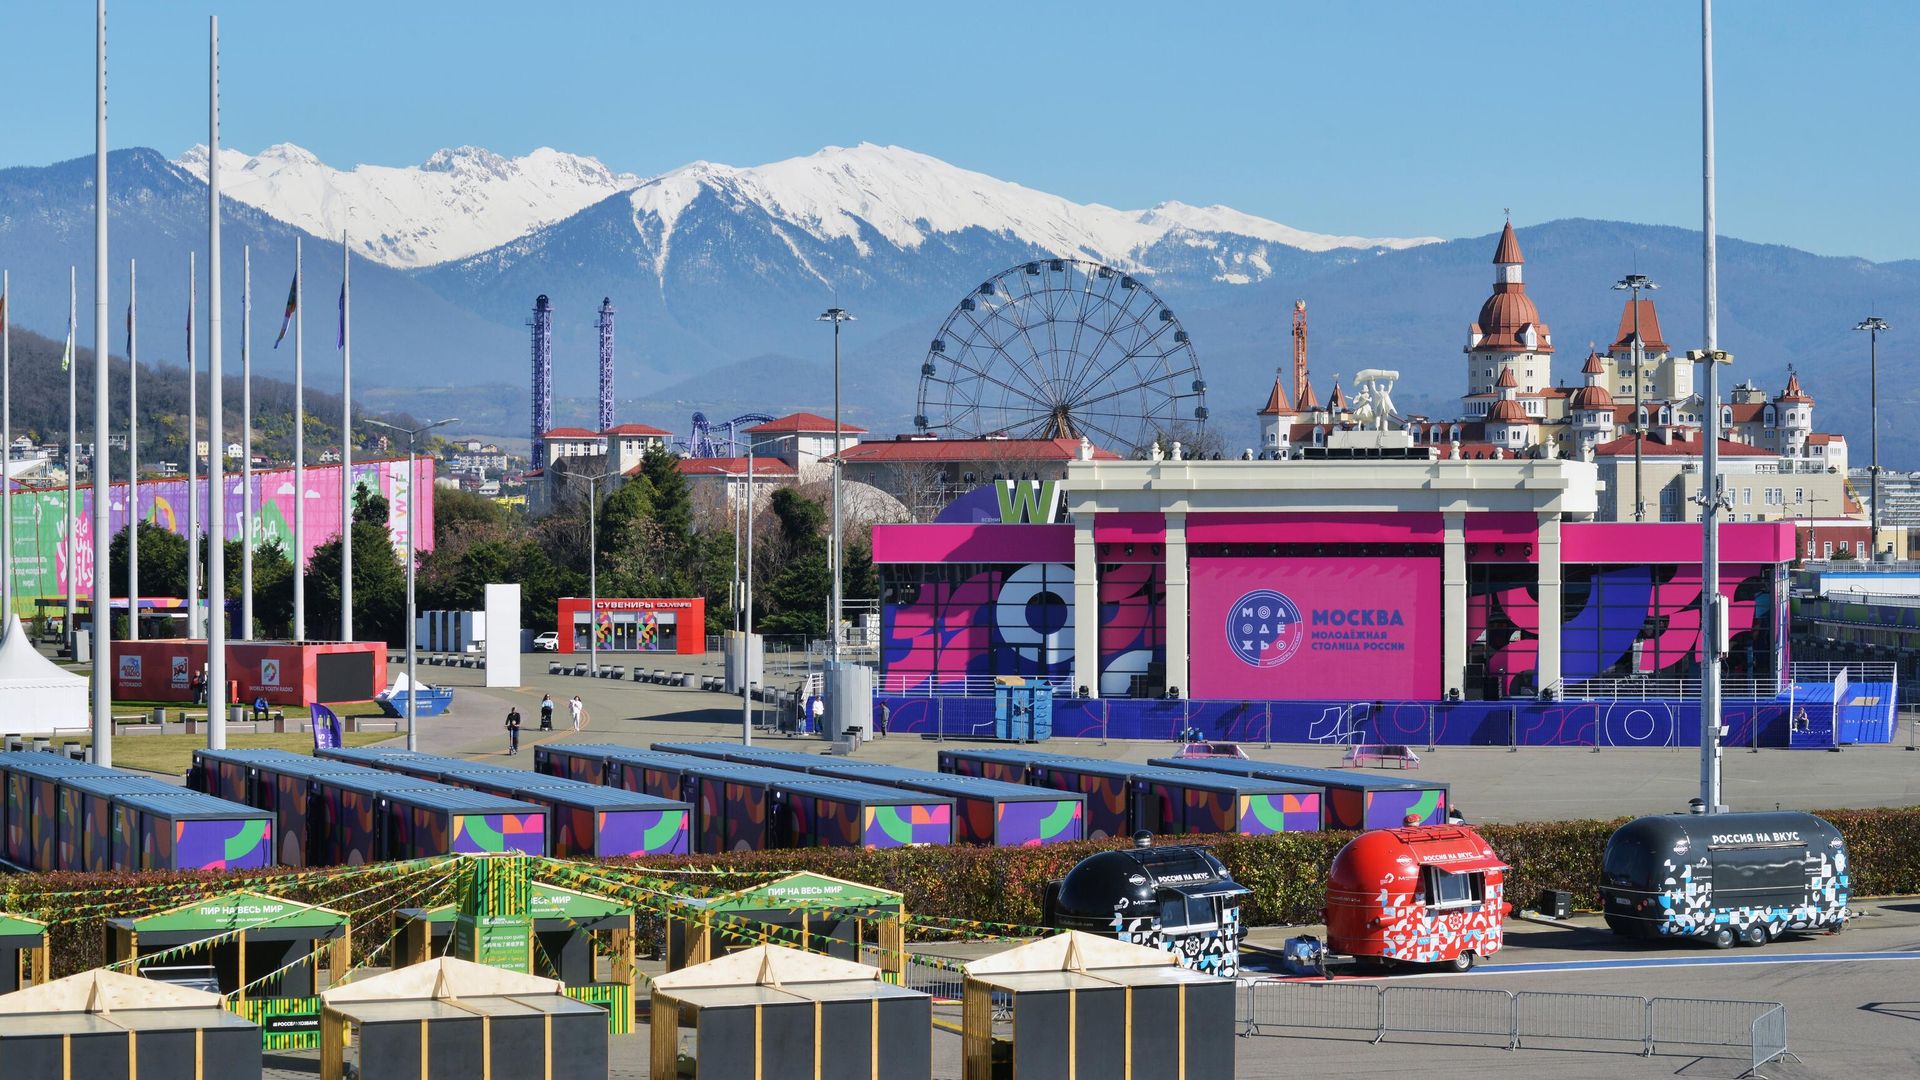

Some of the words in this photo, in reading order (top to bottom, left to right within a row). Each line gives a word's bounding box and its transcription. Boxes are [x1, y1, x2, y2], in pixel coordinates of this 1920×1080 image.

[995, 480, 1054, 524] W
[1312, 609, 1404, 626] МОСКВА
[1311, 629, 1387, 639] МОЛОДЁЖНАЯ
[1311, 642, 1360, 651] СТОЛИЦА
[1363, 642, 1405, 650] РОССИИ
[1712, 834, 1753, 844] РОССИЯ
[1756, 833, 1771, 842] НА
[1774, 832, 1800, 841] ВКУС
[1458, 852, 1473, 860] ВКУС
[1158, 874, 1184, 882] РОССИЯ
[1184, 873, 1193, 881] НА
[1194, 872, 1210, 880] ВКУС
[768, 888, 786, 896] ПИР
[787, 887, 800, 895] НА
[801, 886, 822, 894] ВЕСЬ
[824, 885, 843, 893] МИР
[531, 896, 550, 905] ЕСЬ
[551, 895, 572, 904] МИР
[200, 906, 220, 915] ПИР
[222, 906, 236, 914] НА
[237, 905, 261, 914] ВЕСЬ
[263, 904, 284, 913] МИР
